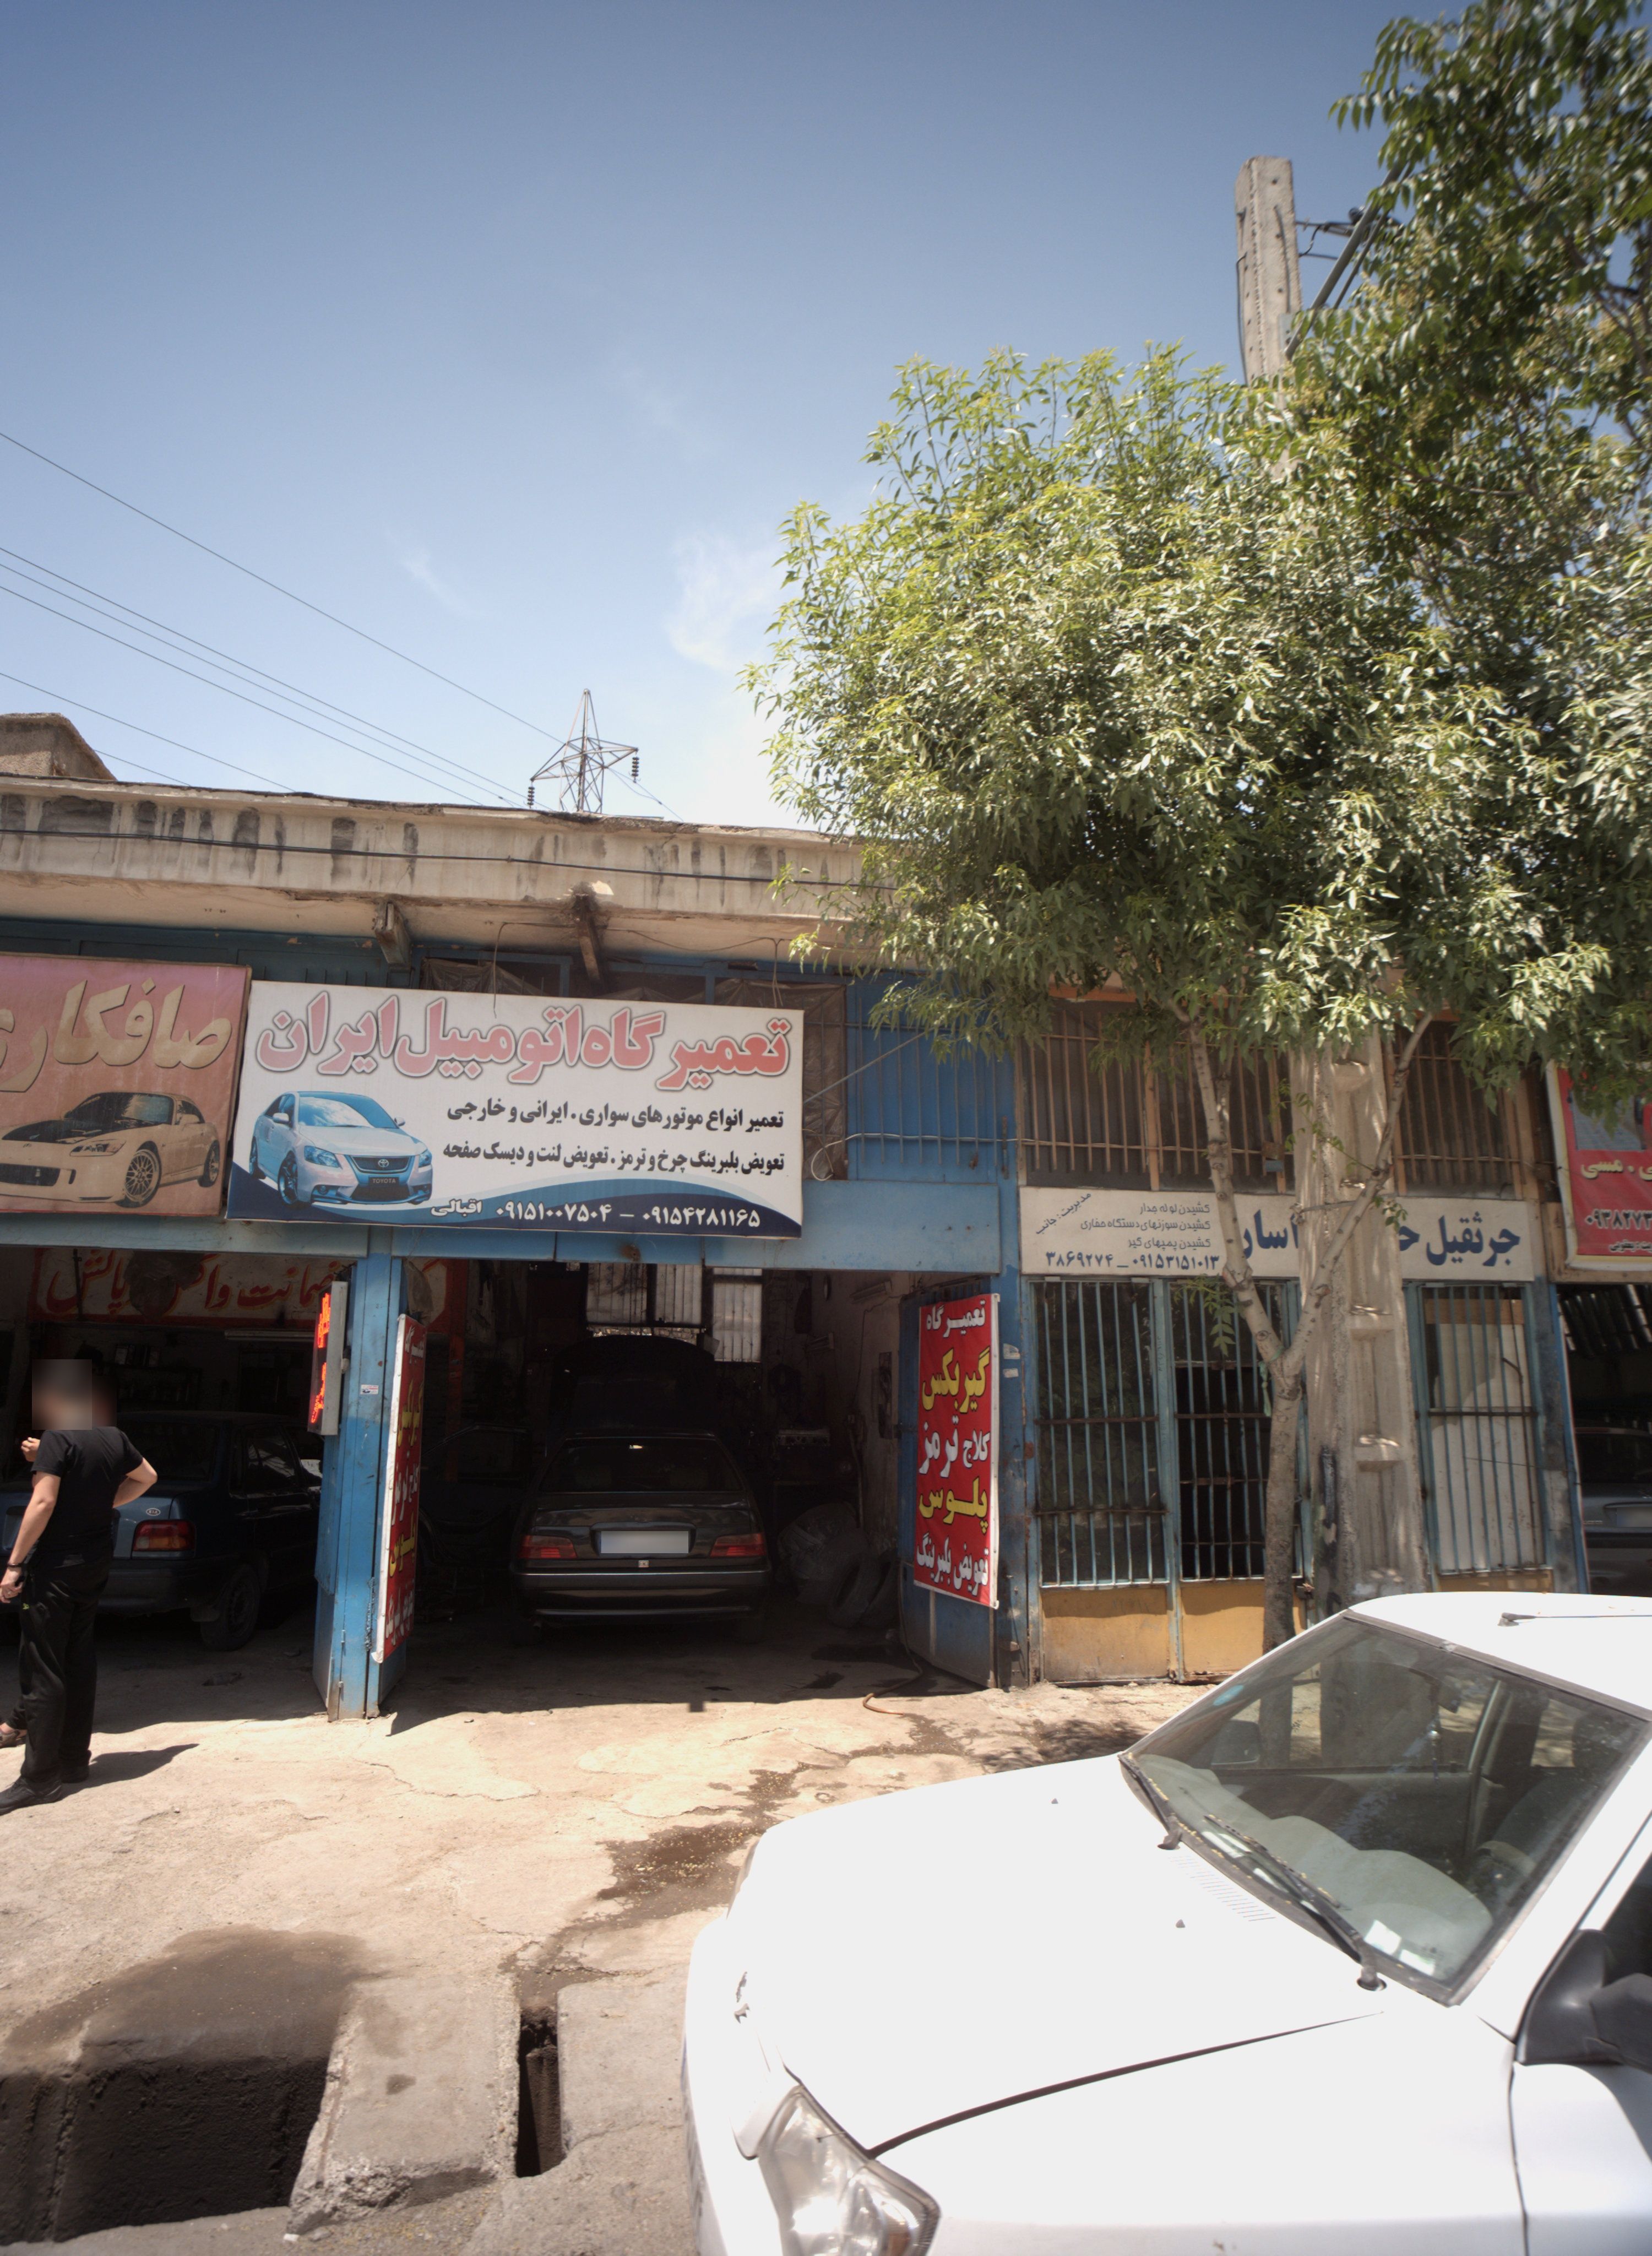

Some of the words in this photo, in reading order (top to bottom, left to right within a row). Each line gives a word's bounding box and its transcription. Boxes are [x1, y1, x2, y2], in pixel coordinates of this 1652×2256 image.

[0, 978, 232, 1093] صافکار
[257, 990, 398, 1075] ایران
[394, 997, 583, 1084] اتومبیل
[448, 1097, 506, 1121] خارجی
[508, 1106, 518, 1122] و
[520, 1100, 568, 1124] ایرانی
[706, 1108, 743, 1131] انواع
[745, 1111, 784, 1132] تعمیر
[443, 1141, 481, 1158] صفحه
[483, 1142, 524, 1165] دیسک
[526, 1150, 534, 1167] و
[536, 1143, 562, 1159] لنت
[563, 1145, 608, 1169] تعویض
[657, 1149, 688, 1173] چرخ
[690, 1149, 739, 1173] بلبرینگ
[647, 1156, 655, 1172] و
[741, 1152, 785, 1175] تعویض
[431, 1198, 482, 1216] اقبالی
[496, 1200, 612, 1222] ۰۹۱۵۱۰۰۷۵۰۴
[643, 1206, 760, 1227] ۰۹۱۵۴۲۸۱۱۶۵
[1179, 1201, 1210, 1215] کشیدن
[1080, 1218, 1106, 1230] حفاری
[1179, 1218, 1211, 1231] کشیدن
[1179, 1237, 1211, 1251] کشیدن
[1426, 1211, 1520, 1267] جرثقیل
[1133, 1253, 1220, 1270] ۰۹۱۵۳۱۵۱۰۱۳
[922, 1346, 991, 1413] گیربکس
[919, 1414, 959, 1478] ترمز
[964, 1429, 991, 1468] کلاج
[918, 1476, 989, 1534] پلوس
[916, 1532, 952, 1585] بلبرینگ
[953, 1542, 990, 1596] تعویض
